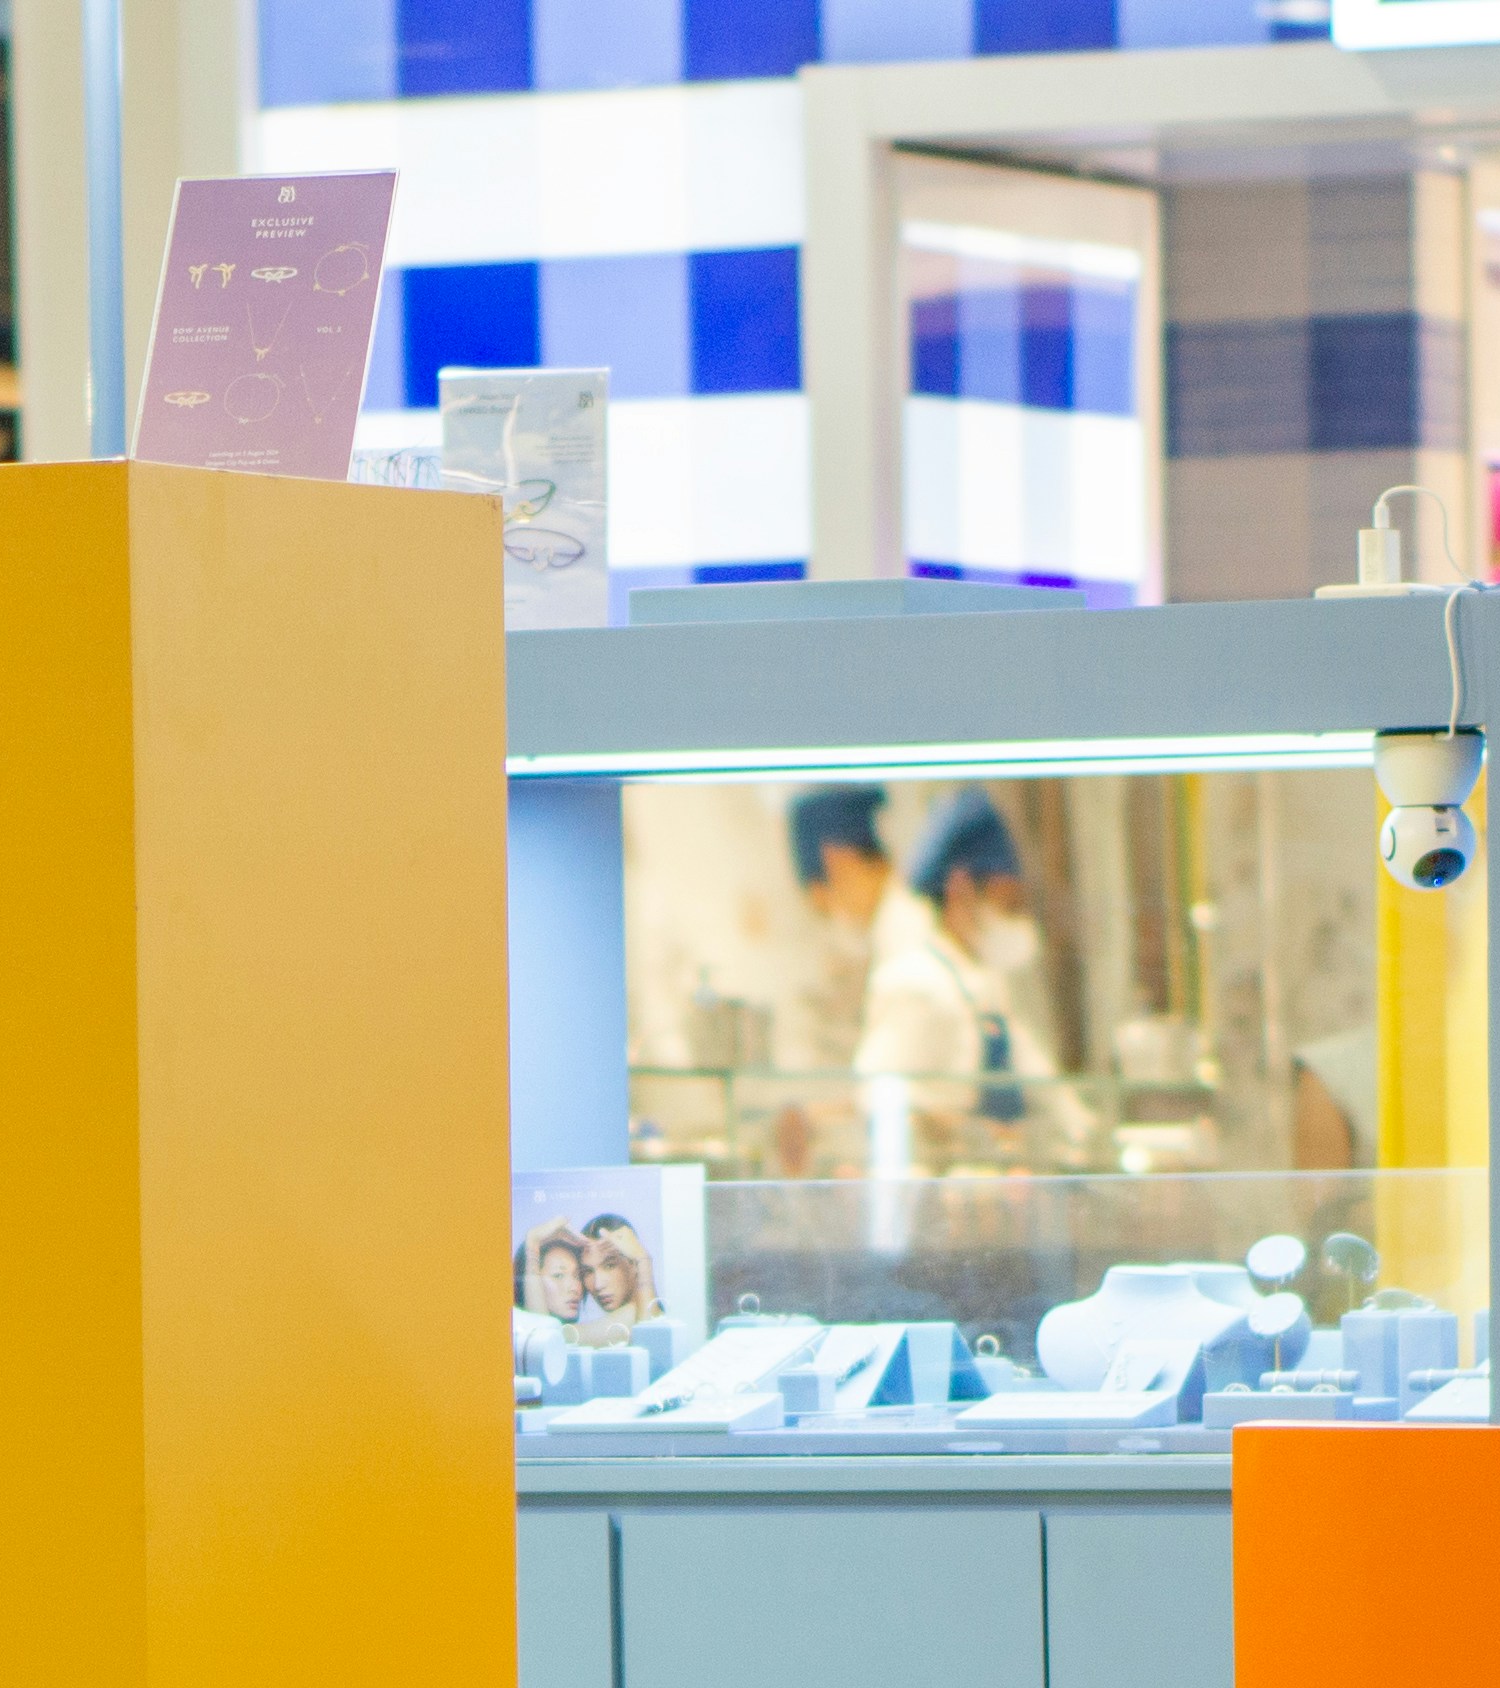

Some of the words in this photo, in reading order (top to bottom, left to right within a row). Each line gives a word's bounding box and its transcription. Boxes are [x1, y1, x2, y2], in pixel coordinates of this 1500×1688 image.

[250, 215, 315, 228] EXCLUSIVE
[255, 229, 307, 240] PREVIEW
[172, 335, 228, 343] COLLECTION
